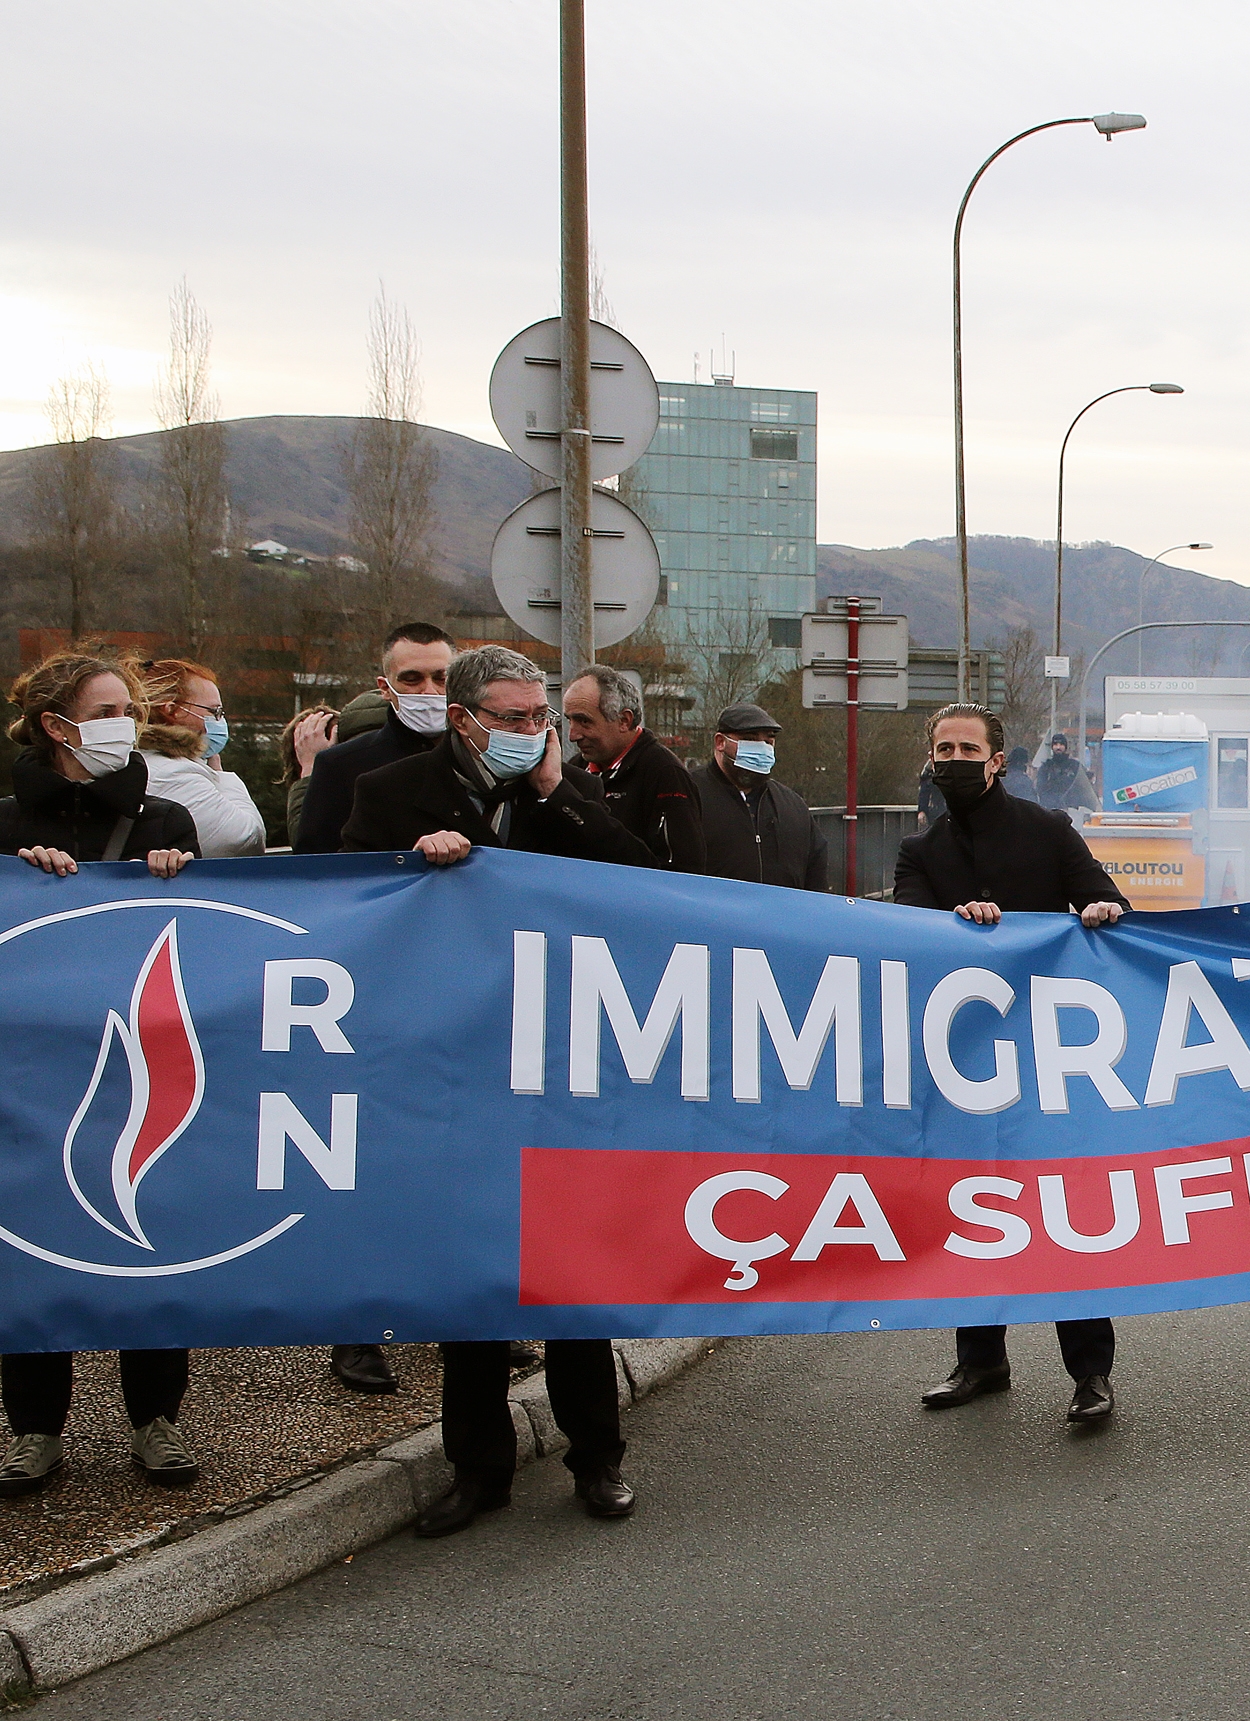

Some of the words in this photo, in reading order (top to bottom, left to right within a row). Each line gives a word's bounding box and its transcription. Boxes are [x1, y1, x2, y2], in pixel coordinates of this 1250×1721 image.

[1117, 681, 1130, 690] 05
[1133, 681, 1146, 690] 58
[1149, 681, 1162, 690] 57
[1165, 681, 1178, 690] 39
[1181, 681, 1194, 690] 00
[1135, 770, 1195, 796] location
[1129, 877, 1184, 887] ENERGIE
[684, 1170, 907, 1291] ÇA
